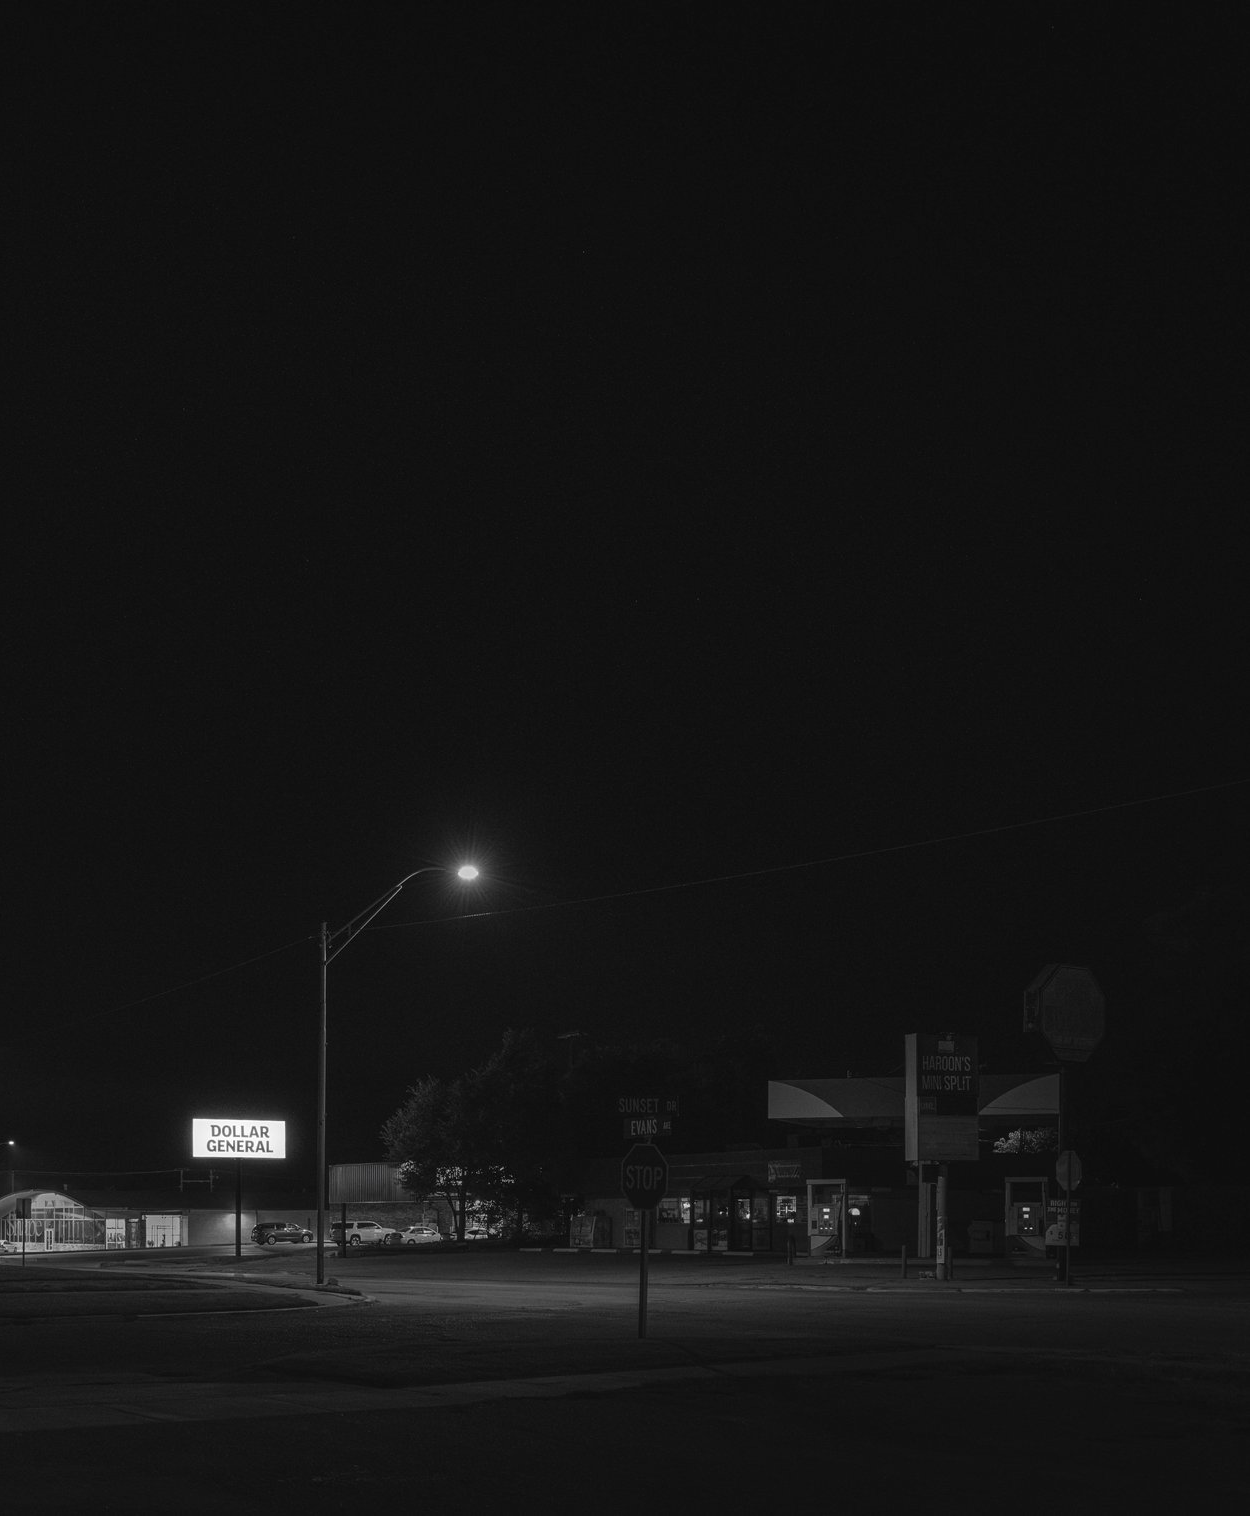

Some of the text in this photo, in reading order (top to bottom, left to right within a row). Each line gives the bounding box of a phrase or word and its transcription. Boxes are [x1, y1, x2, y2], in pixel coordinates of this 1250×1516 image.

[922, 1055, 971, 1072] HAROON'S
[922, 1075, 972, 1091] MINI SPLIT
[618, 1097, 677, 1113] SUNSET DR
[210, 1124, 270, 1138] DOLLAR
[630, 1119, 658, 1136] EVANS
[207, 1139, 274, 1153] GENERAL
[626, 1165, 664, 1191] STOP
